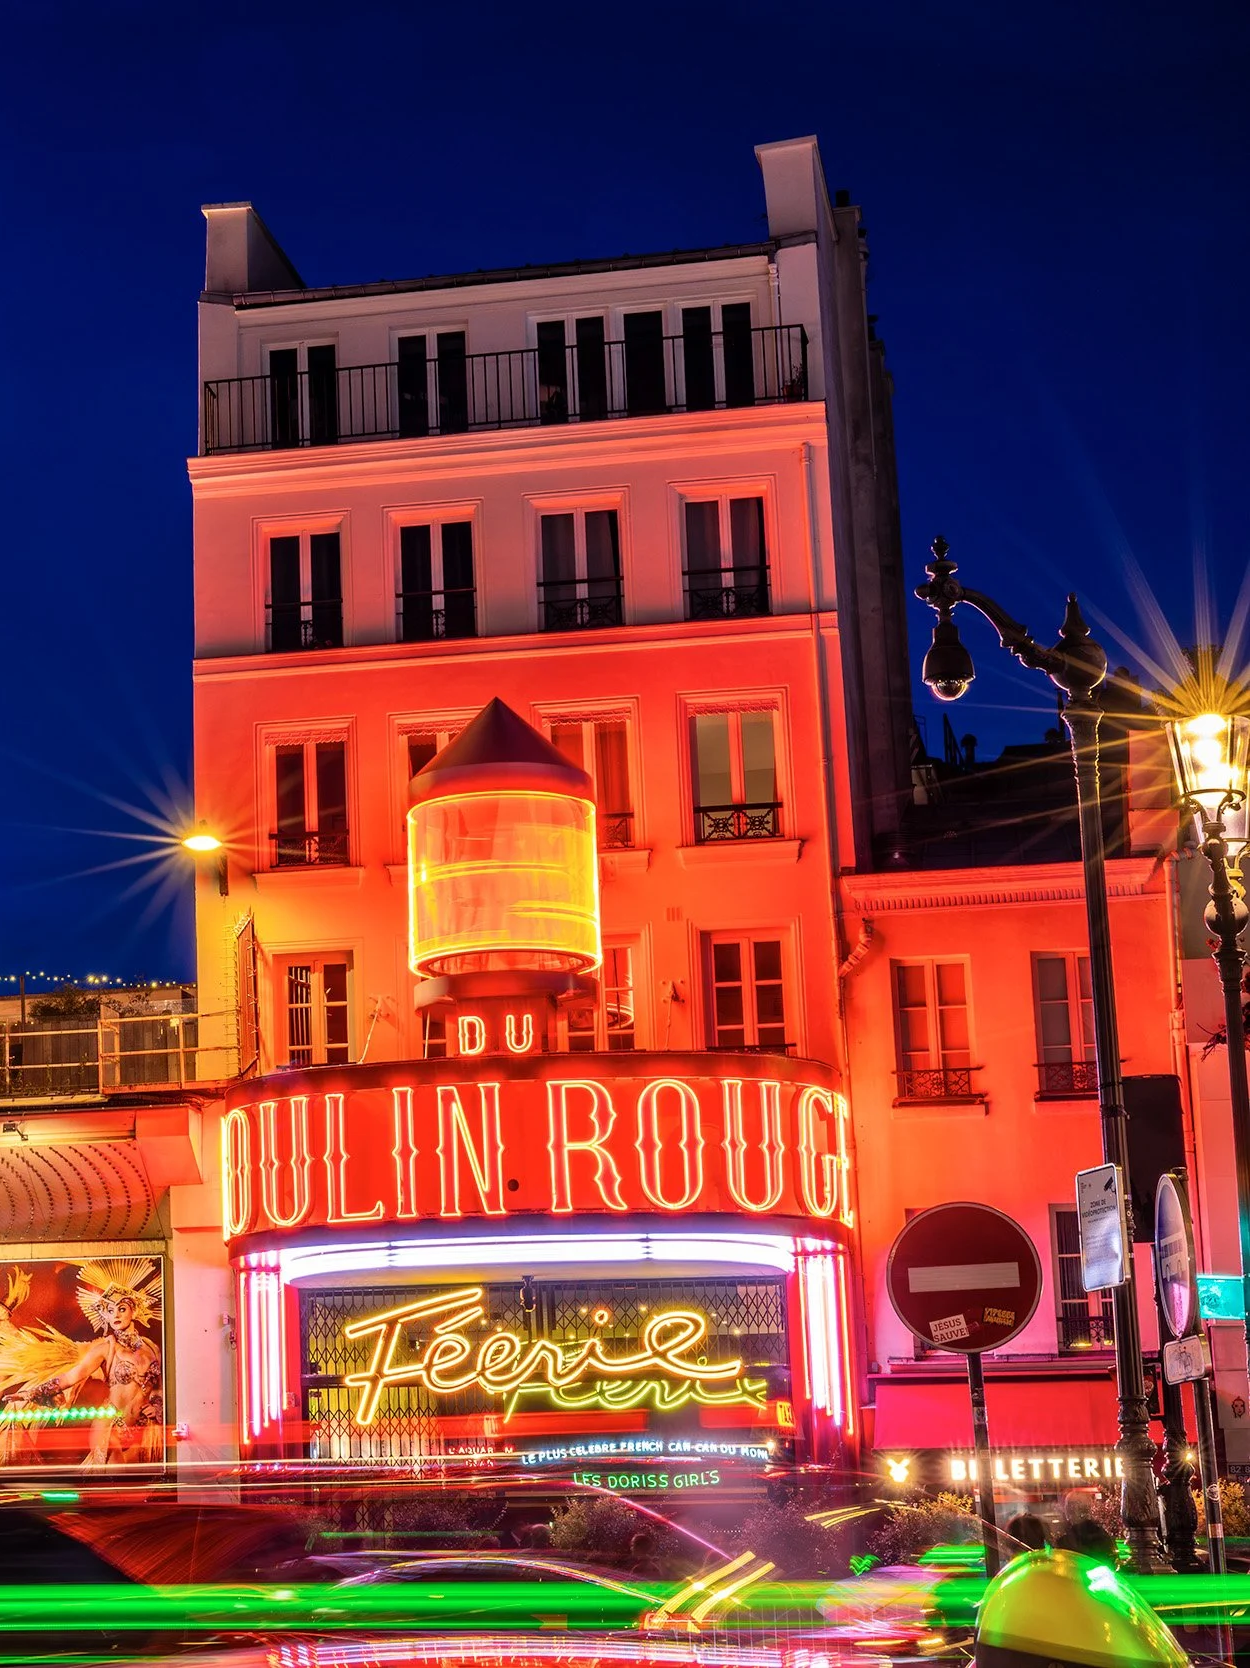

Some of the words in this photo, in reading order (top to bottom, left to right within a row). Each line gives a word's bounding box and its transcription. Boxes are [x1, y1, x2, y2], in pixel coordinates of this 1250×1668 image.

[458, 1014, 534, 1055] DU
[221, 1081, 507, 1241] OULIN
[345, 1287, 742, 1426] Féerie
[521, 1453, 536, 1465] LE
[538, 1448, 567, 1462] PLUS
[619, 1440, 663, 1453] FRENCH
[720, 1443, 736, 1455] DU
[573, 1472, 602, 1487] LES
[607, 1474, 669, 1489] DORISS
[950, 1457, 1127, 1482] BILETTERIE
